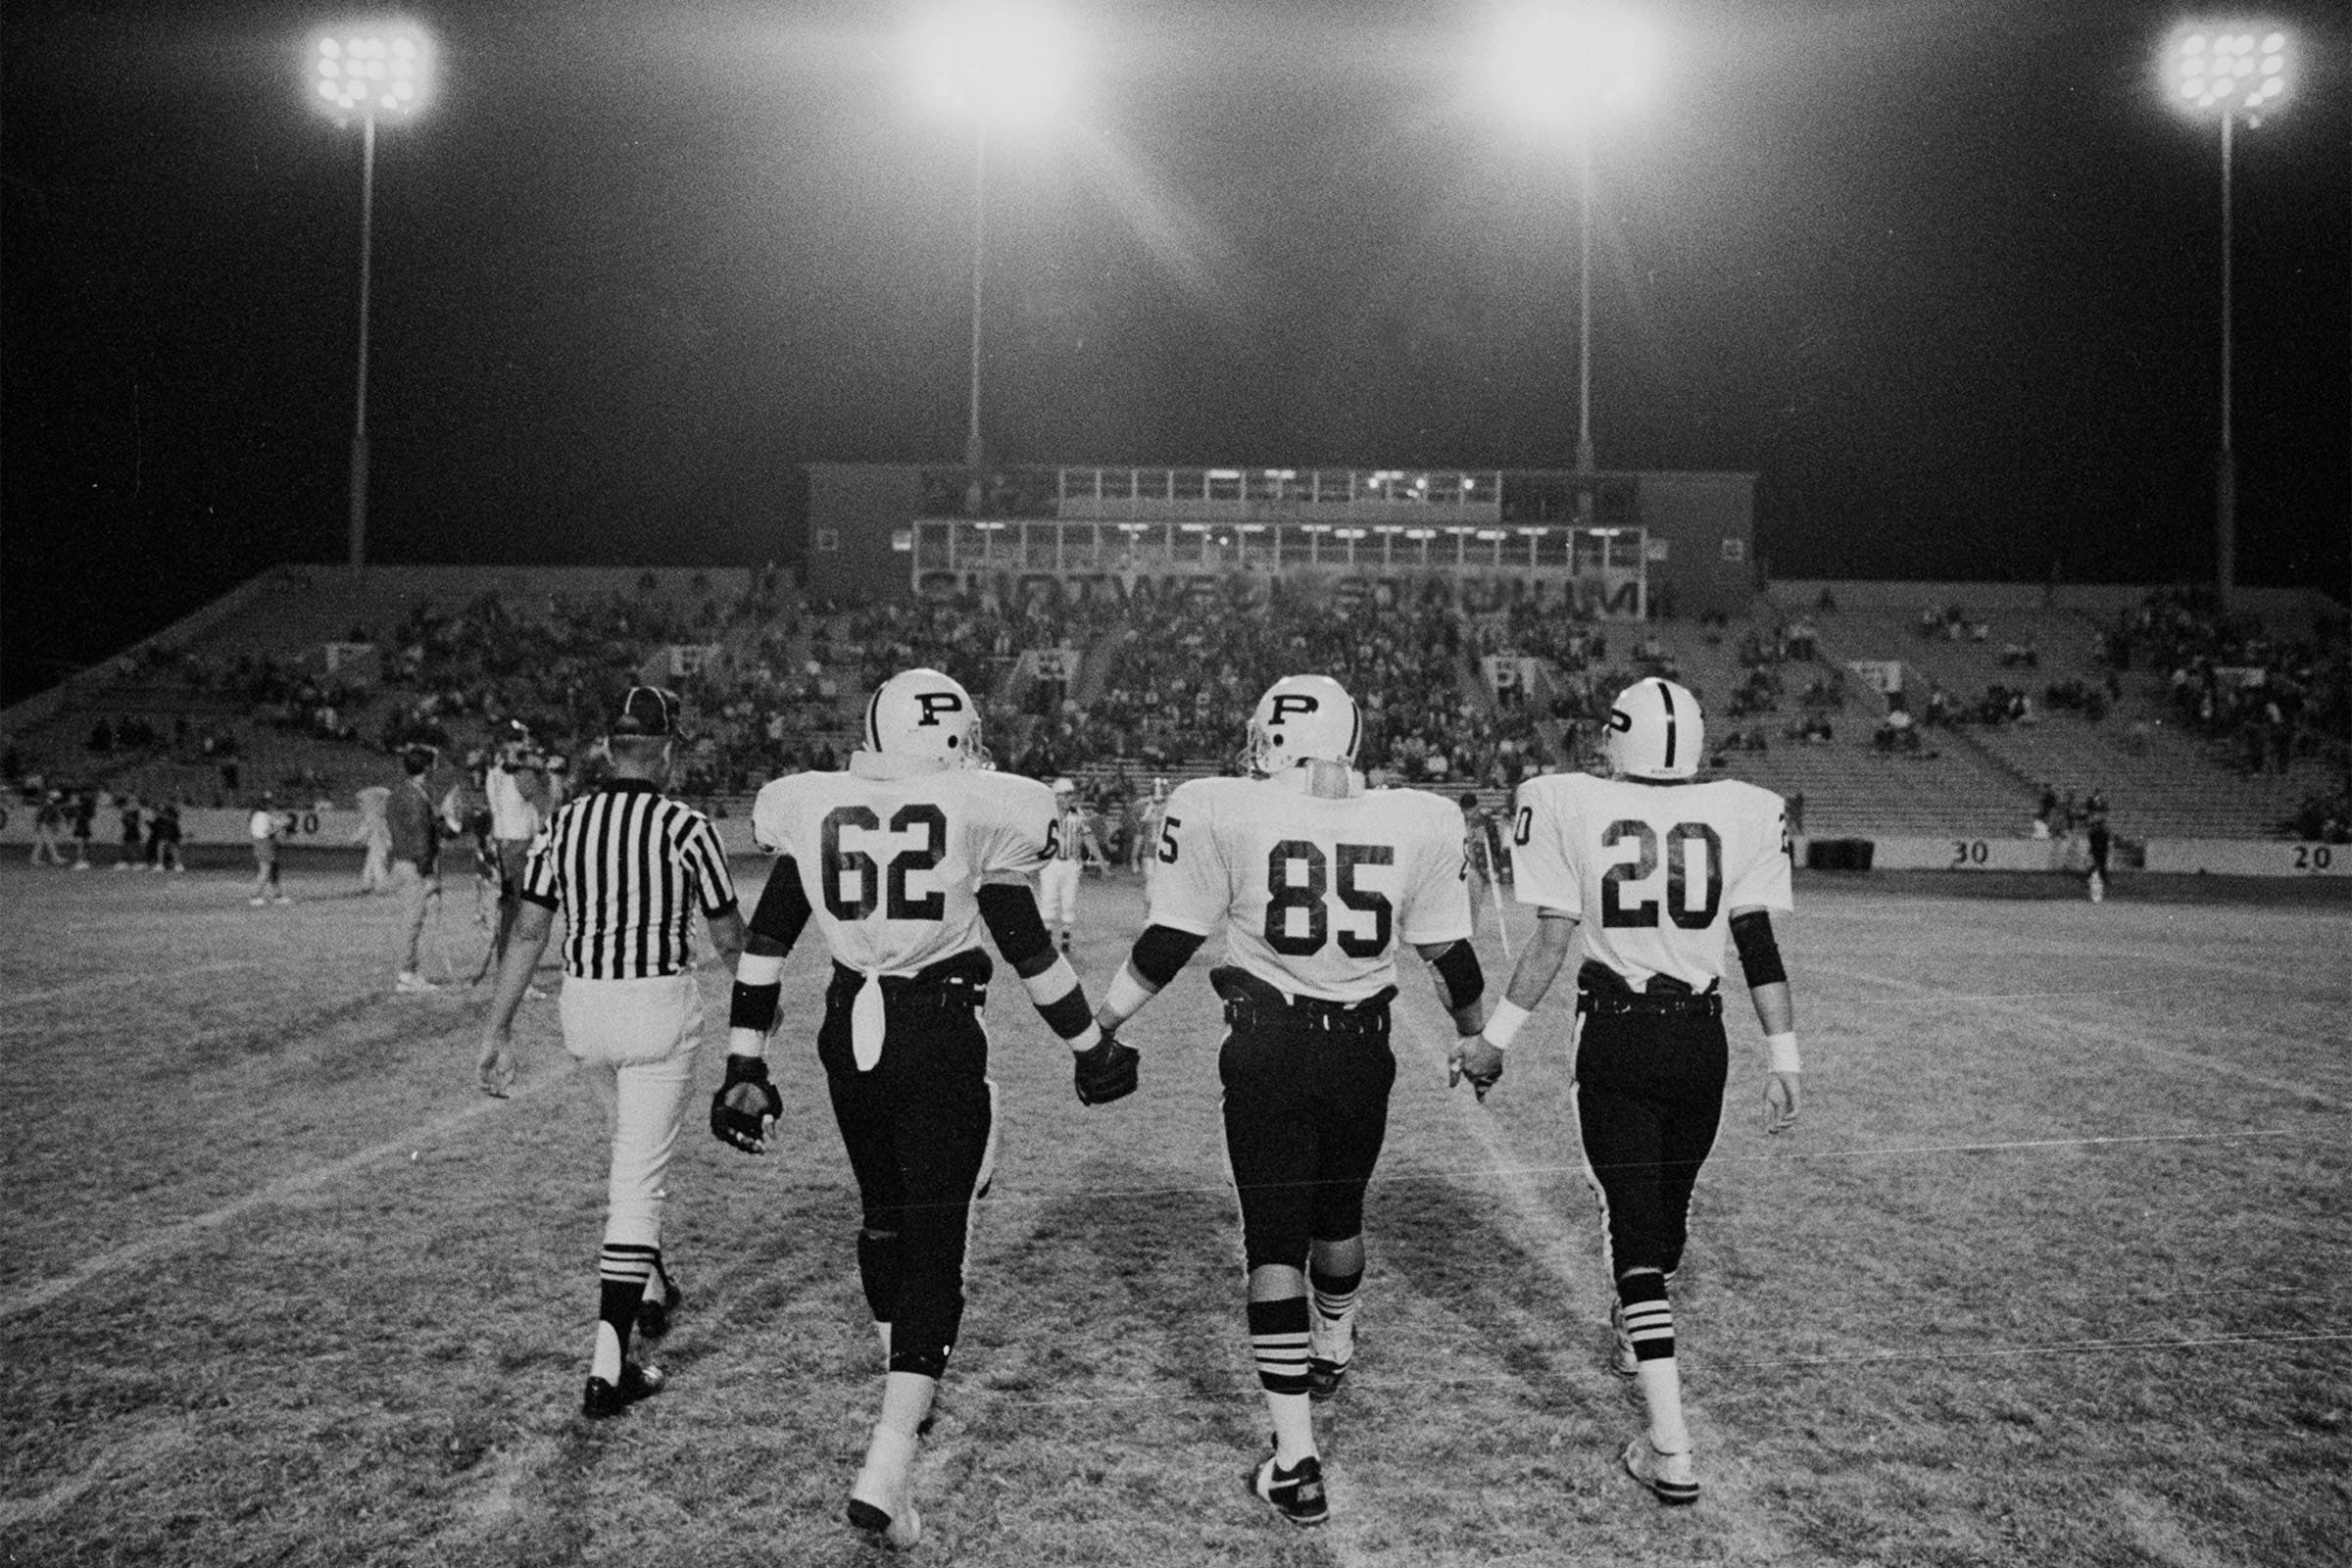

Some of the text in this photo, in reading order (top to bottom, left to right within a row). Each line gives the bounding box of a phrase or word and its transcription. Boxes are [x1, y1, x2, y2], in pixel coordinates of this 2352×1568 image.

[915, 693, 962, 726] P
[1268, 694, 1319, 725] P
[283, 813, 318, 835] 20
[821, 804, 947, 921] 62
[1952, 840, 1988, 865] 30
[2292, 846, 2331, 870] 20
[1601, 820, 1723, 929] 20
[1264, 840, 1395, 958] 85
